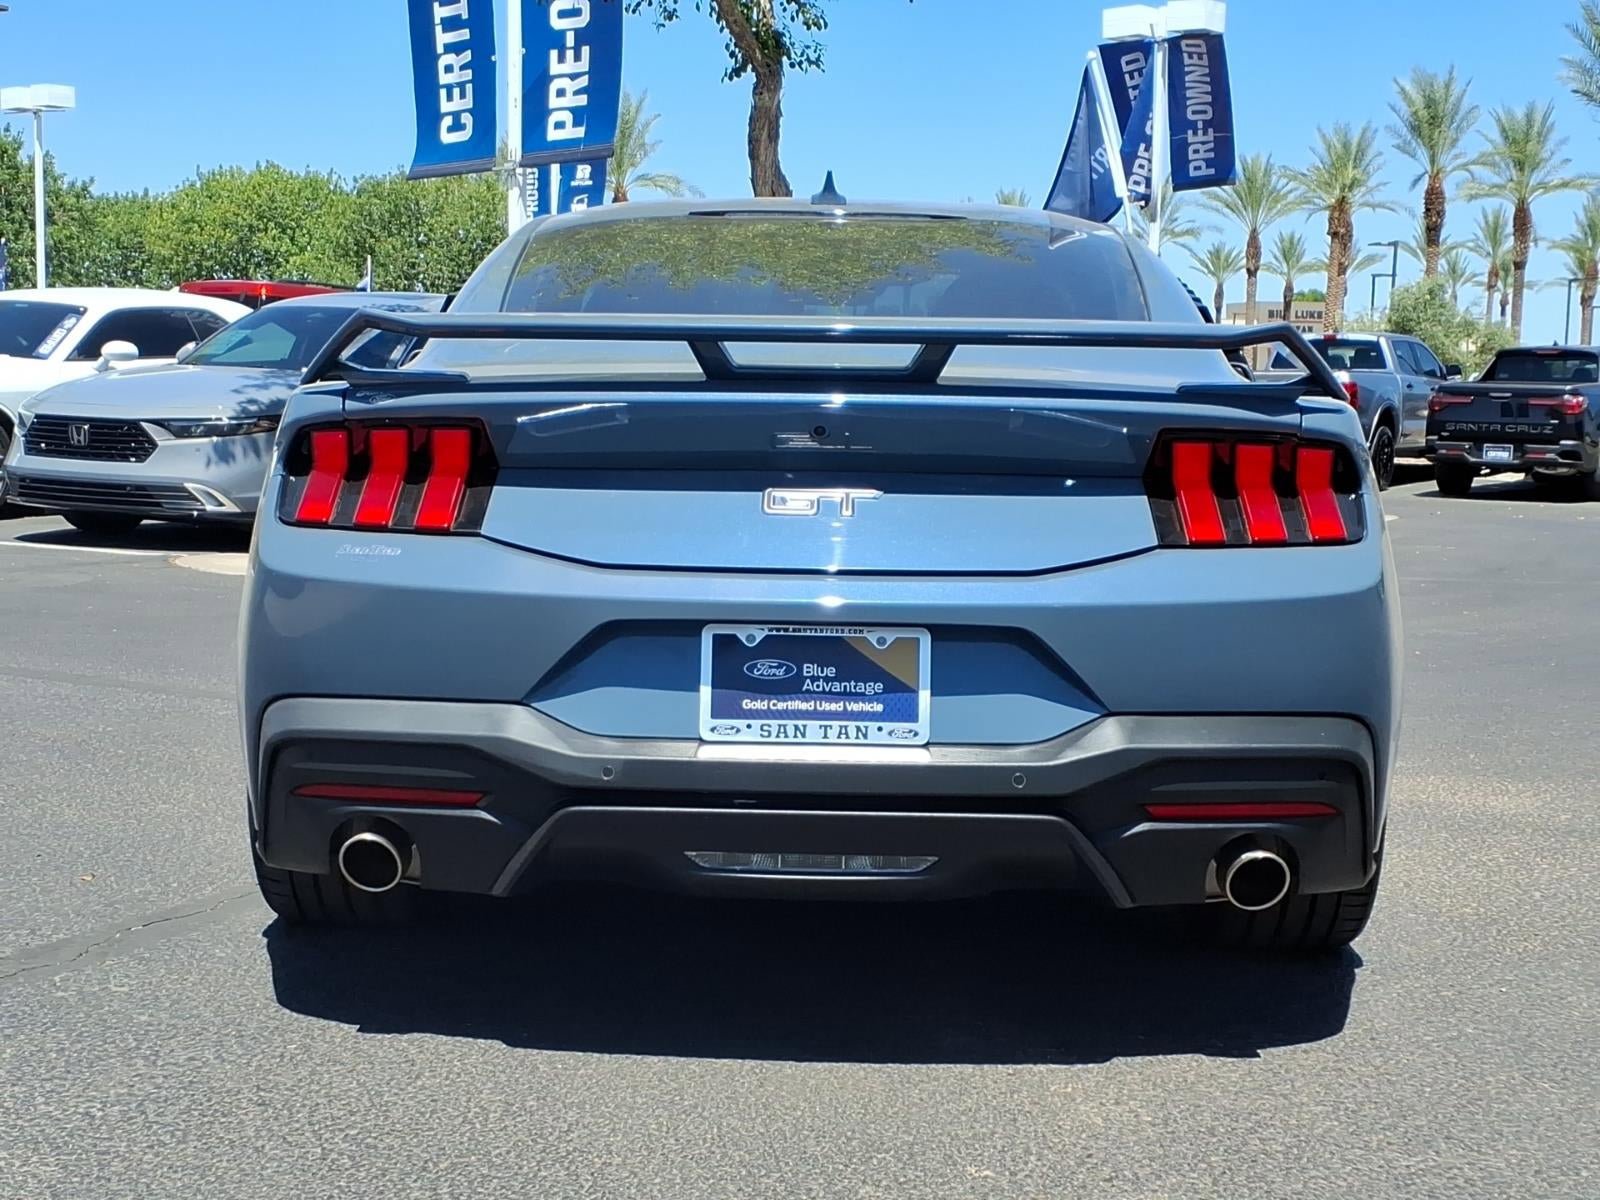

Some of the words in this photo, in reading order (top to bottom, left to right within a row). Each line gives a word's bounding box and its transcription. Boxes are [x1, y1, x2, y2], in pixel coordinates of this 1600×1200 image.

[1180, 39, 1216, 178] PRE-OWNED
[1295, 310, 1324, 319] LUKE
[1445, 422, 1501, 432] SANTA
[1505, 424, 1555, 434] CRUZ
[763, 488, 884, 517] GT
[753, 661, 787, 677] Ford
[803, 664, 837, 677] Blue
[802, 679, 884, 695] Advantage
[742, 699, 768, 711] Gold
[769, 700, 814, 711] Certified
[816, 701, 844, 712] Used
[846, 702, 884, 712] Vehicle
[759, 724, 808, 739] SAN
[819, 725, 870, 740] TAN
